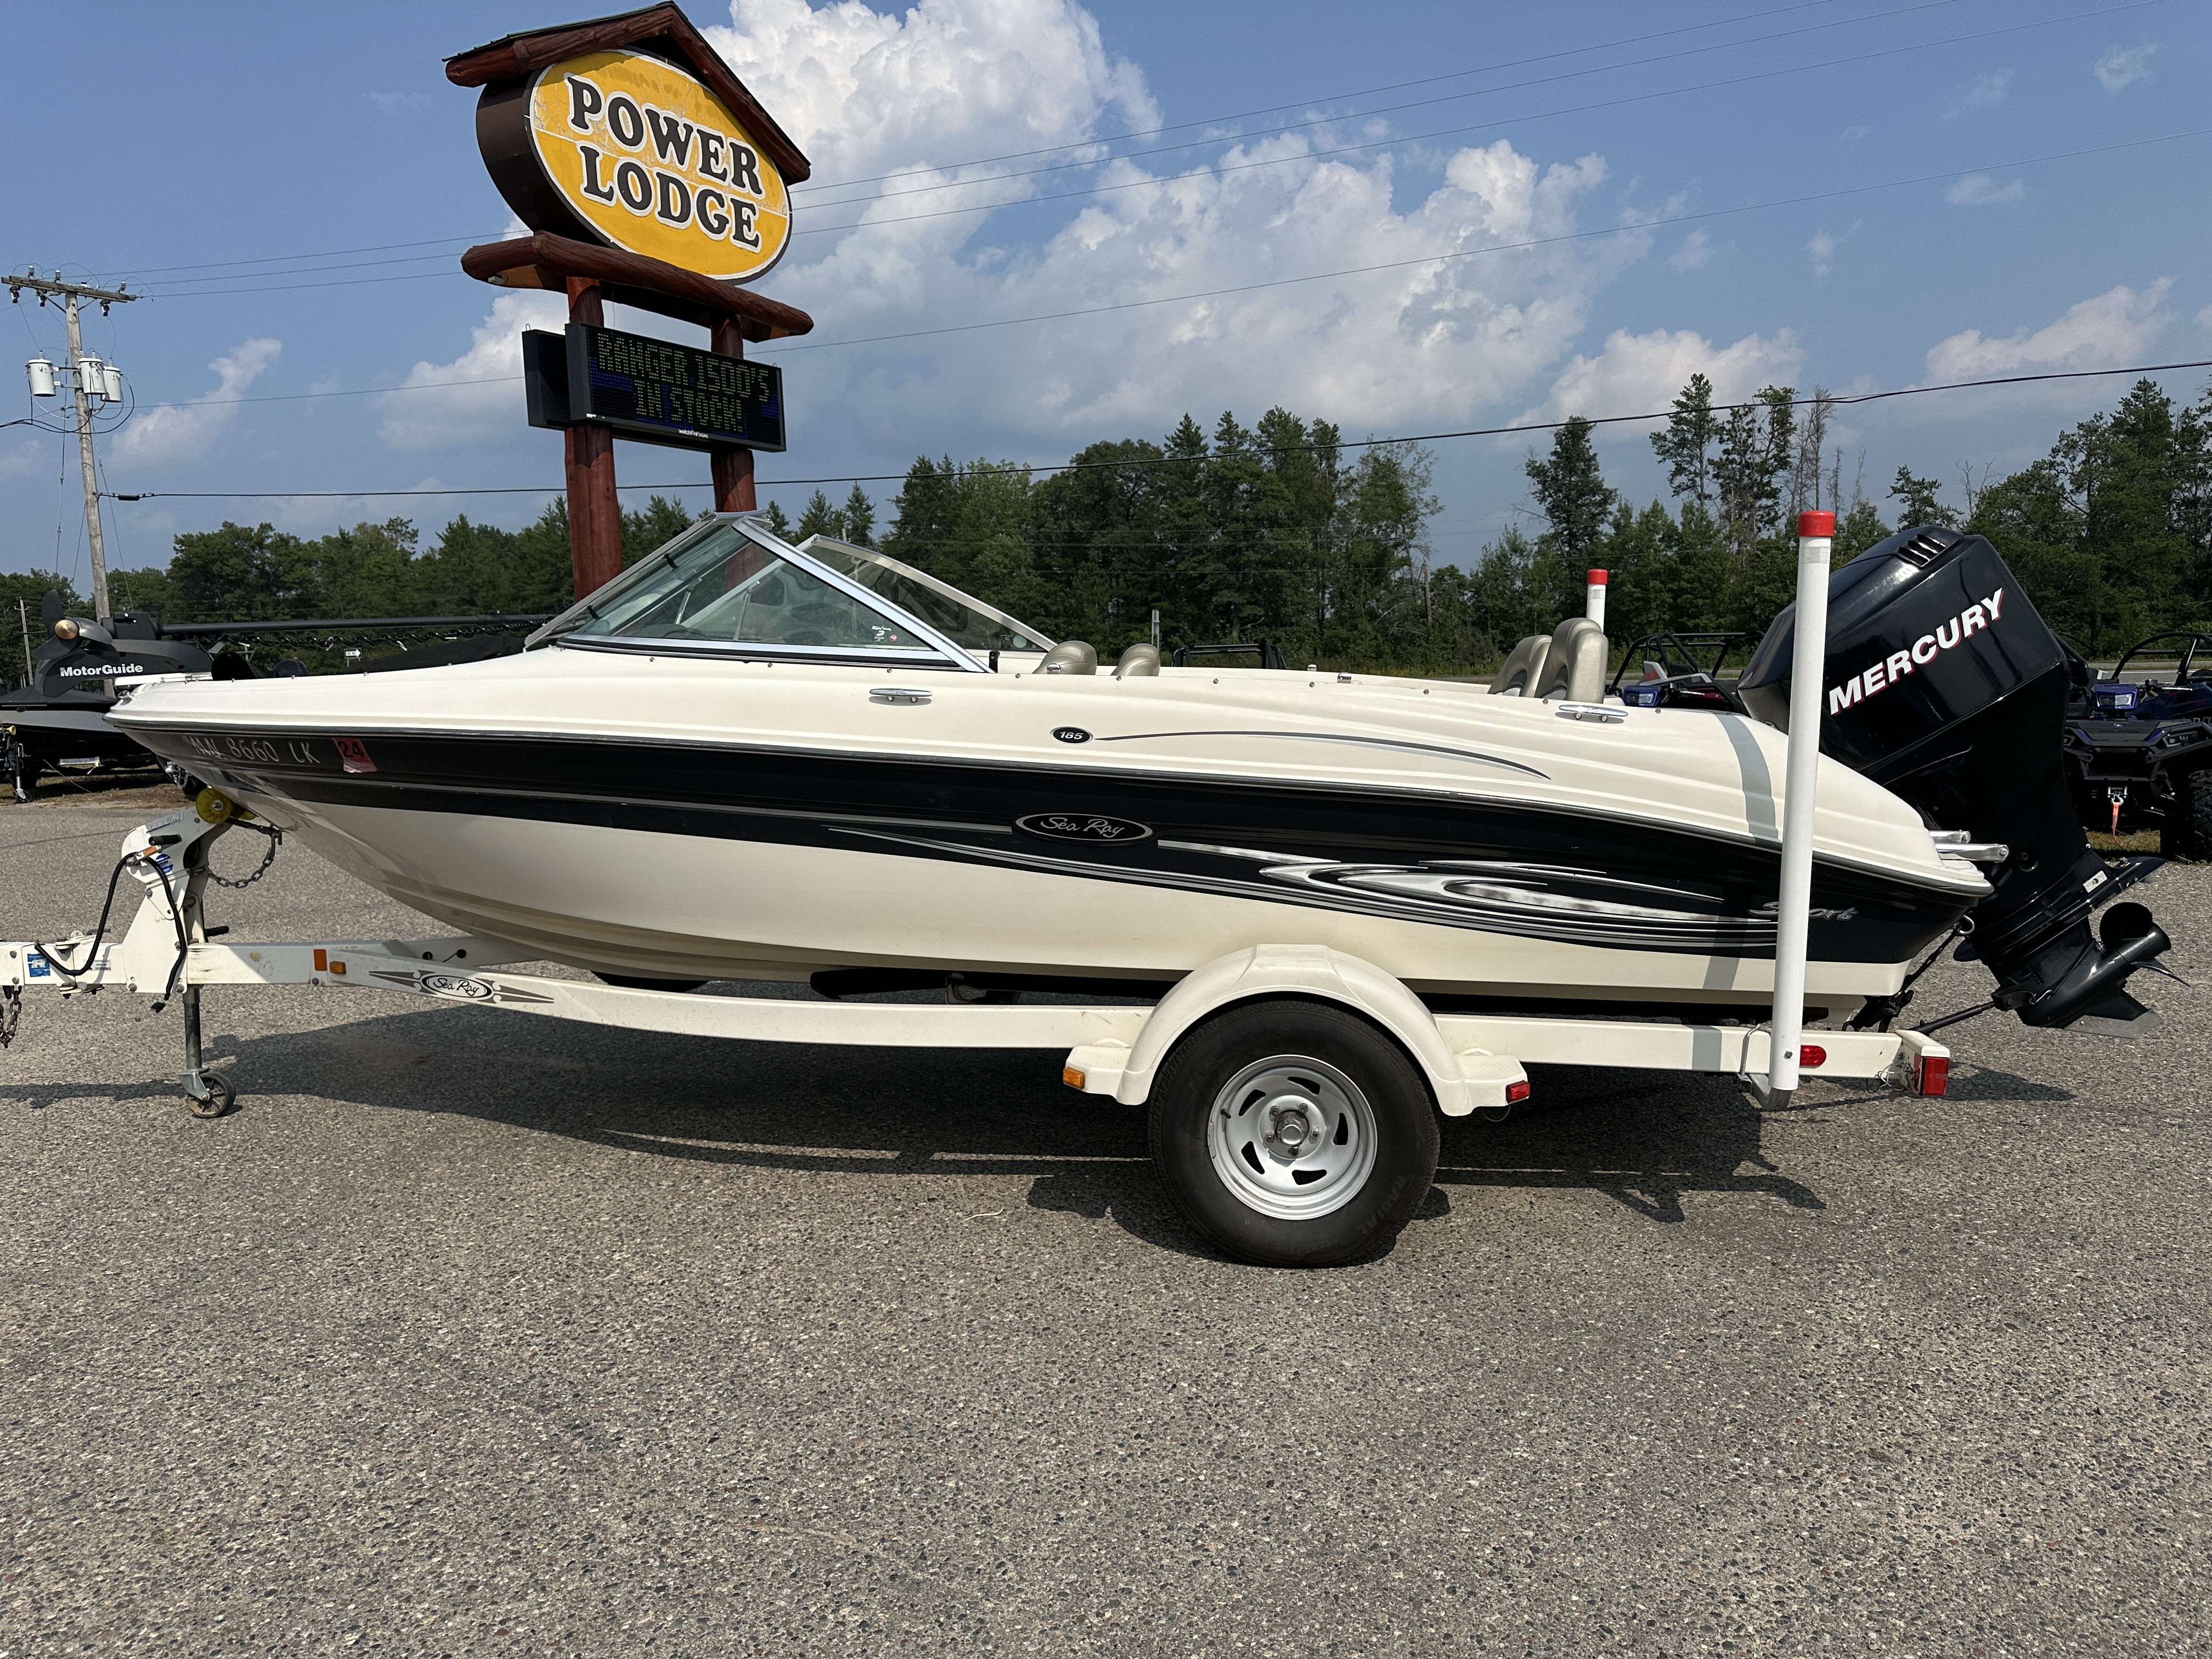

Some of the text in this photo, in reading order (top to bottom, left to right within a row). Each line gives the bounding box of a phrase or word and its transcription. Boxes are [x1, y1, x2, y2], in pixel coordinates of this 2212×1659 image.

[566, 75, 764, 196] POWER
[578, 144, 762, 250] LODGE
[597, 333, 689, 385] RANGER
[634, 380, 662, 418] IN
[1827, 587, 2005, 716] MERCURY
[60, 663, 143, 677] MotorGuide
[1059, 731, 1084, 740] 185
[227, 737, 279, 762] 8660
[289, 741, 320, 763] LK
[338, 741, 365, 758] 24
[1040, 817, 1125, 838] Sea Ray
[1747, 901, 1859, 921] Sort
[433, 978, 479, 996] Sea Ray
